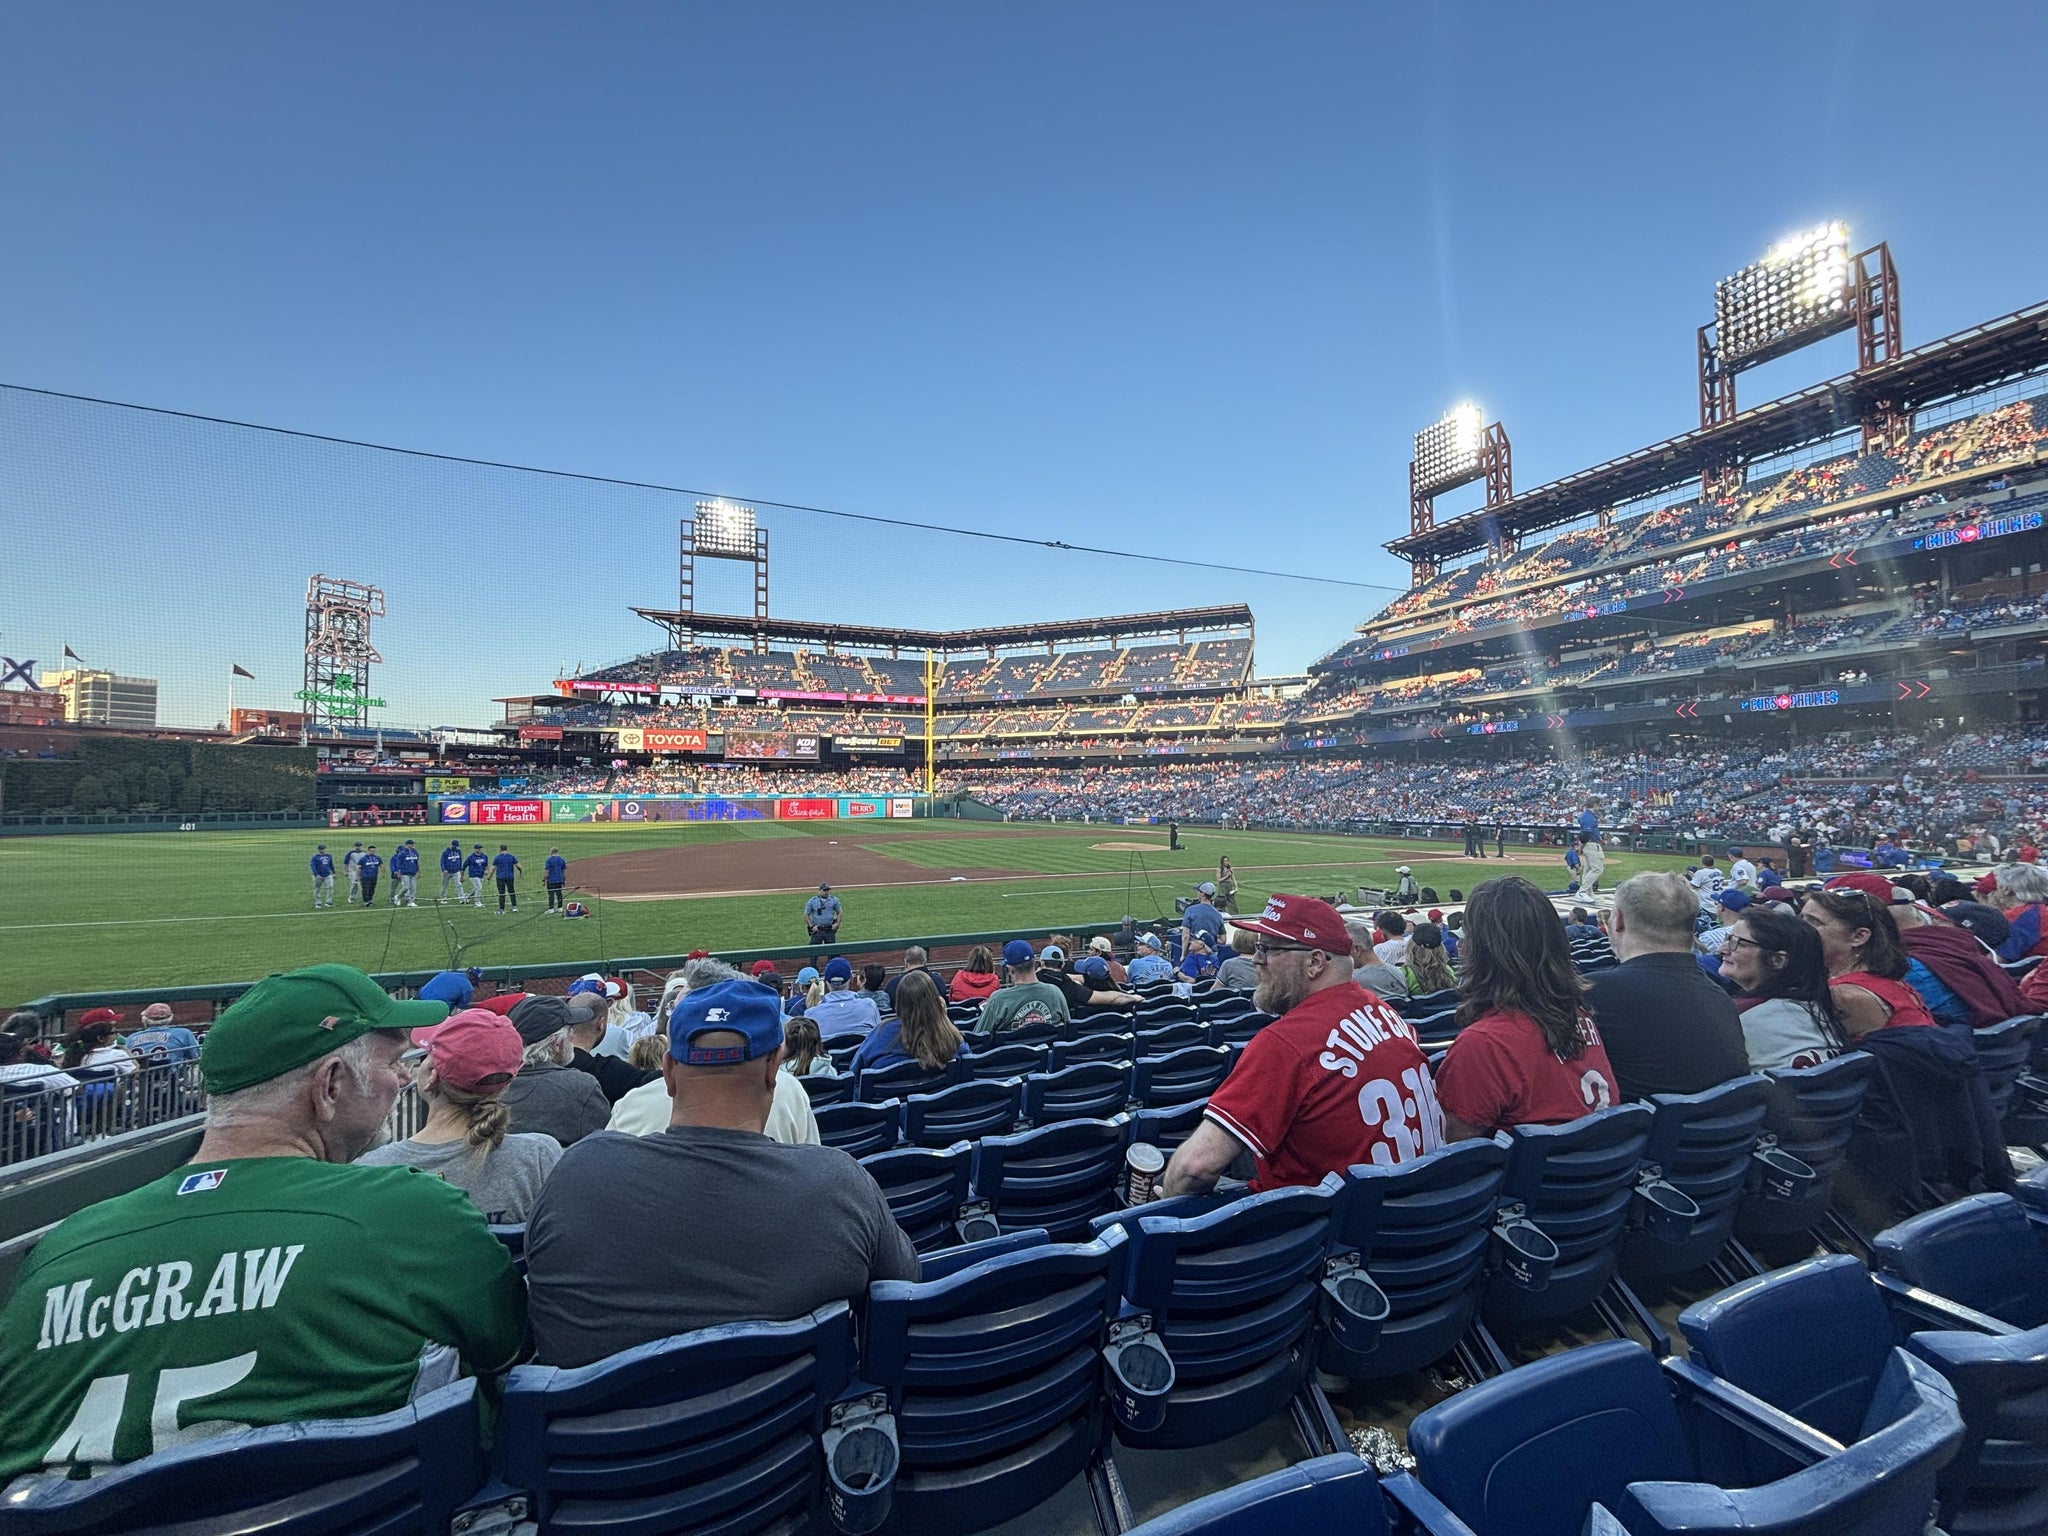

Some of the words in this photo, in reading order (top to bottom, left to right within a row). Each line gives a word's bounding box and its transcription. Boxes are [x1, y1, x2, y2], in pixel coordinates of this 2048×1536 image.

[1925, 529, 1962, 550] CUBS
[1976, 511, 2043, 540] PHILLIES
[1750, 696, 1777, 711] CUBS
[1790, 690, 1839, 709] PHILLIES
[646, 734, 702, 746] TOYOTA
[503, 804, 539, 814] Temple
[851, 804, 873, 813] HERR'S
[503, 813, 536, 821] Health
[179, 823, 196, 831] 401
[1319, 1004, 1391, 1079] STONE
[36, 1244, 305, 1351] McGRAW
